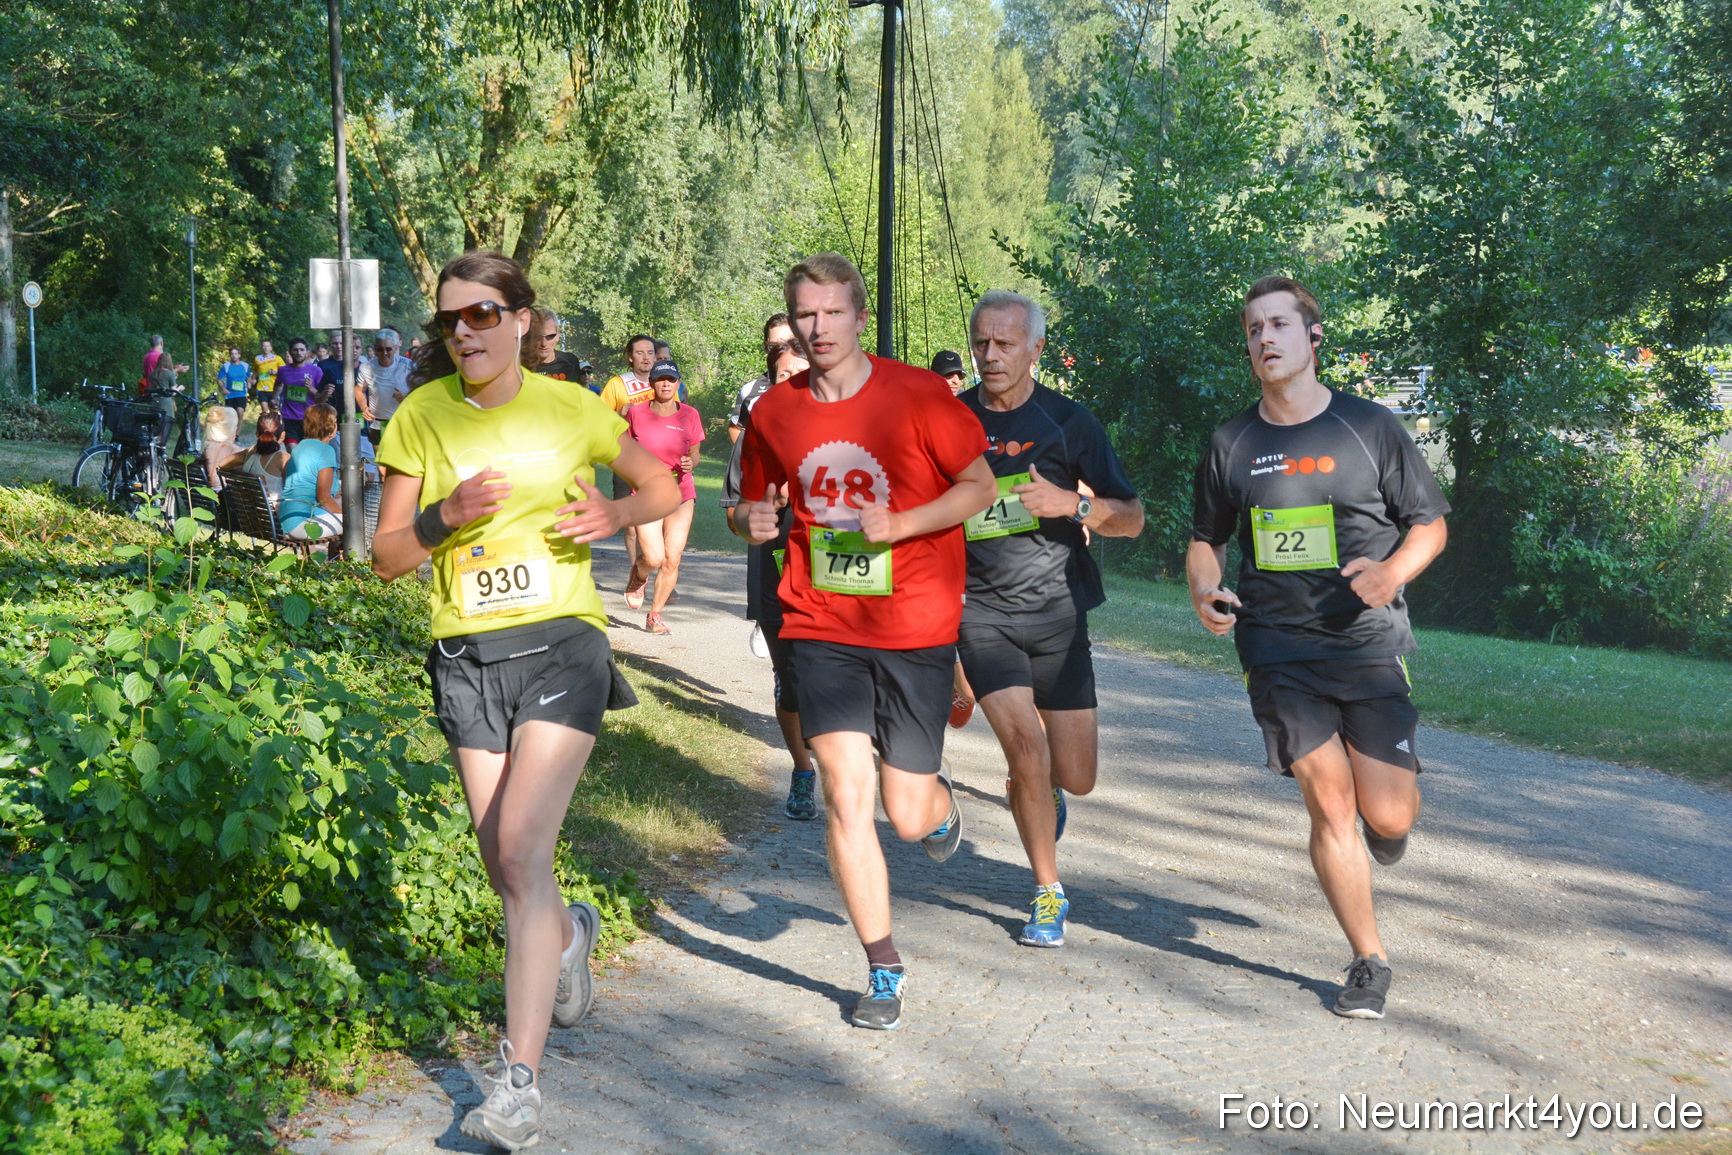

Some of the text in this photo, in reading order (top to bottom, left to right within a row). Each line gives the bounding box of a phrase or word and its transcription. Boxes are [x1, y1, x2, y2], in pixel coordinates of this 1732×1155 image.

[629, 393, 650, 404] MAX
[1255, 453, 1284, 464] APTIV
[1250, 463, 1289, 476] Running Team
[809, 465, 876, 510] 48
[998, 517, 1021, 526] Thomas
[1274, 530, 1306, 553] 22
[825, 552, 871, 577] 779
[476, 564, 531, 597] 930
[824, 574, 847, 584] Schmitz
